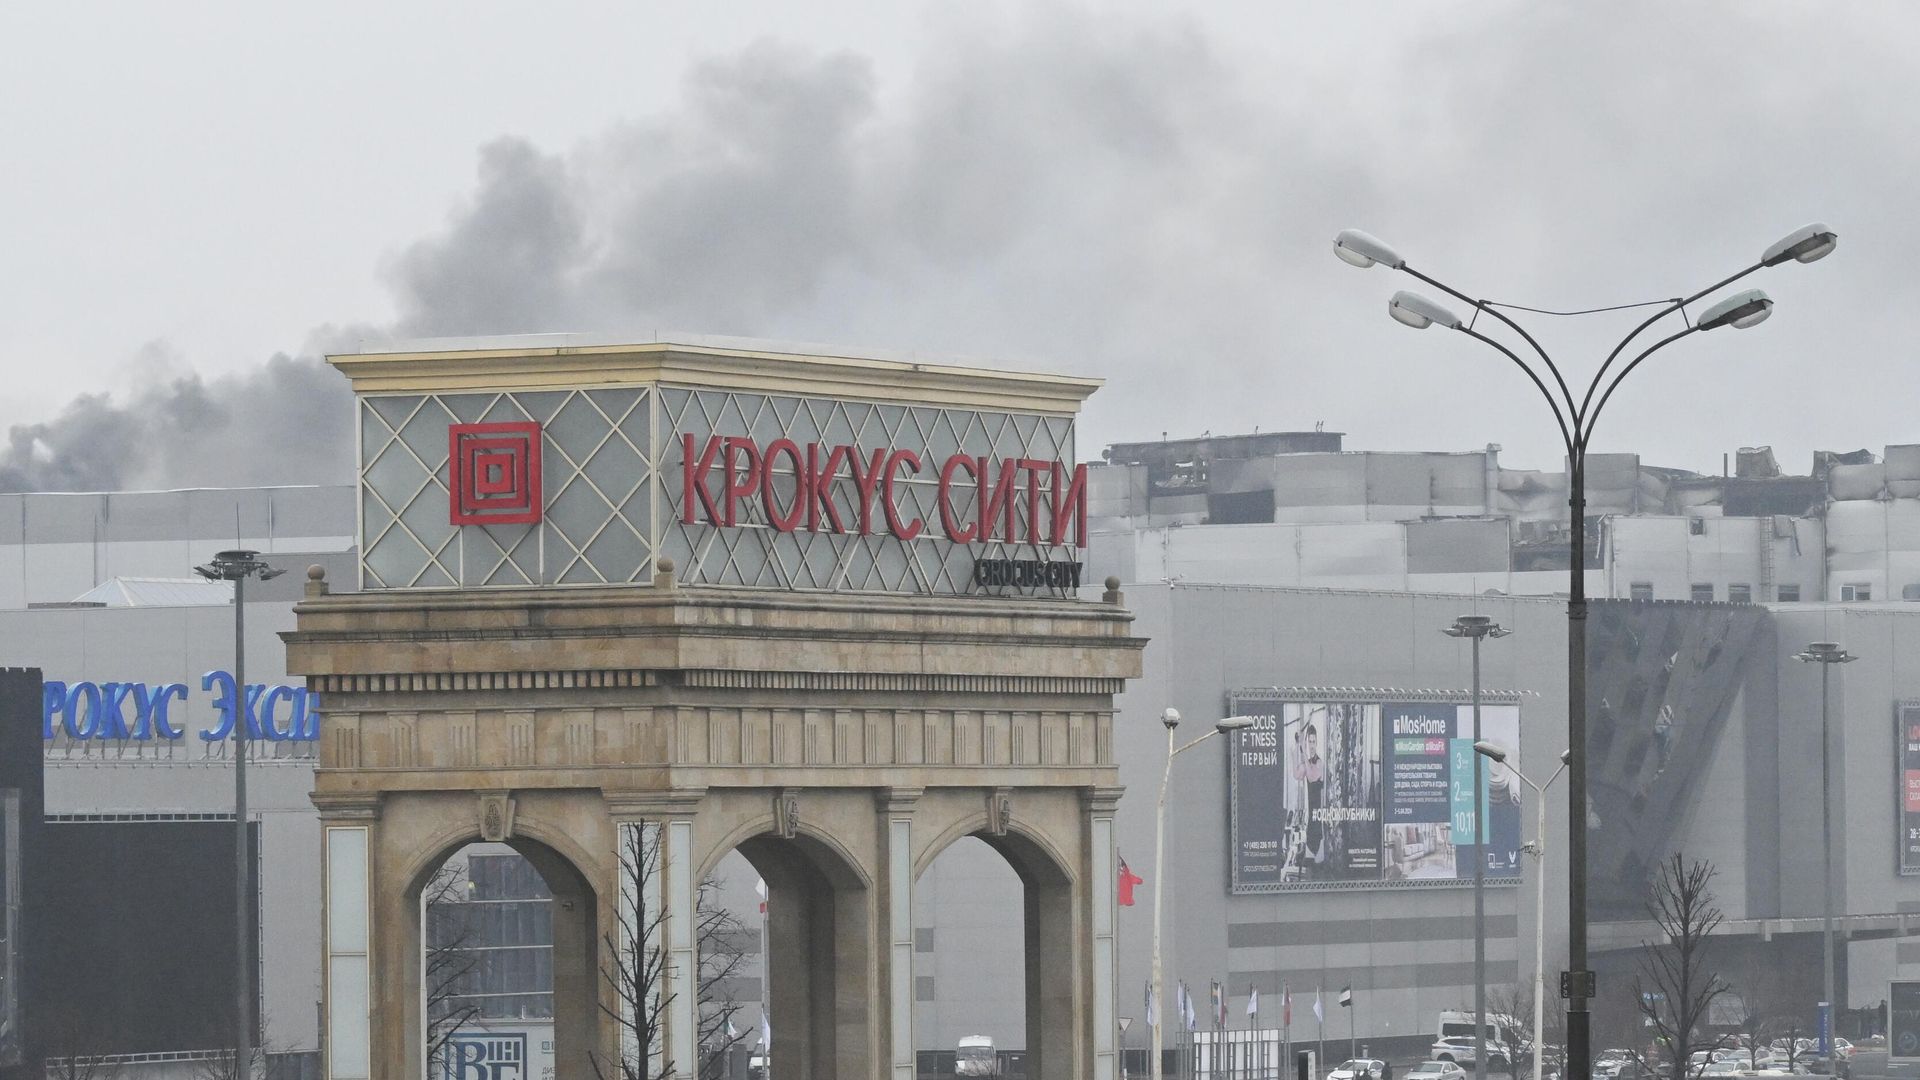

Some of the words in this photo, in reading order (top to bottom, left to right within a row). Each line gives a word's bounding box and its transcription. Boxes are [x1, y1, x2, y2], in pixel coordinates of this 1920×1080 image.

[683, 433, 922, 541] КРОКУС
[938, 454, 1087, 548] СИТИ
[974, 558, 1046, 587] CROCUS
[1046, 560, 1084, 588] CITY
[1400, 714, 1446, 734] MosHome
[1242, 748, 1278, 766] ПЕРВЫЙ
